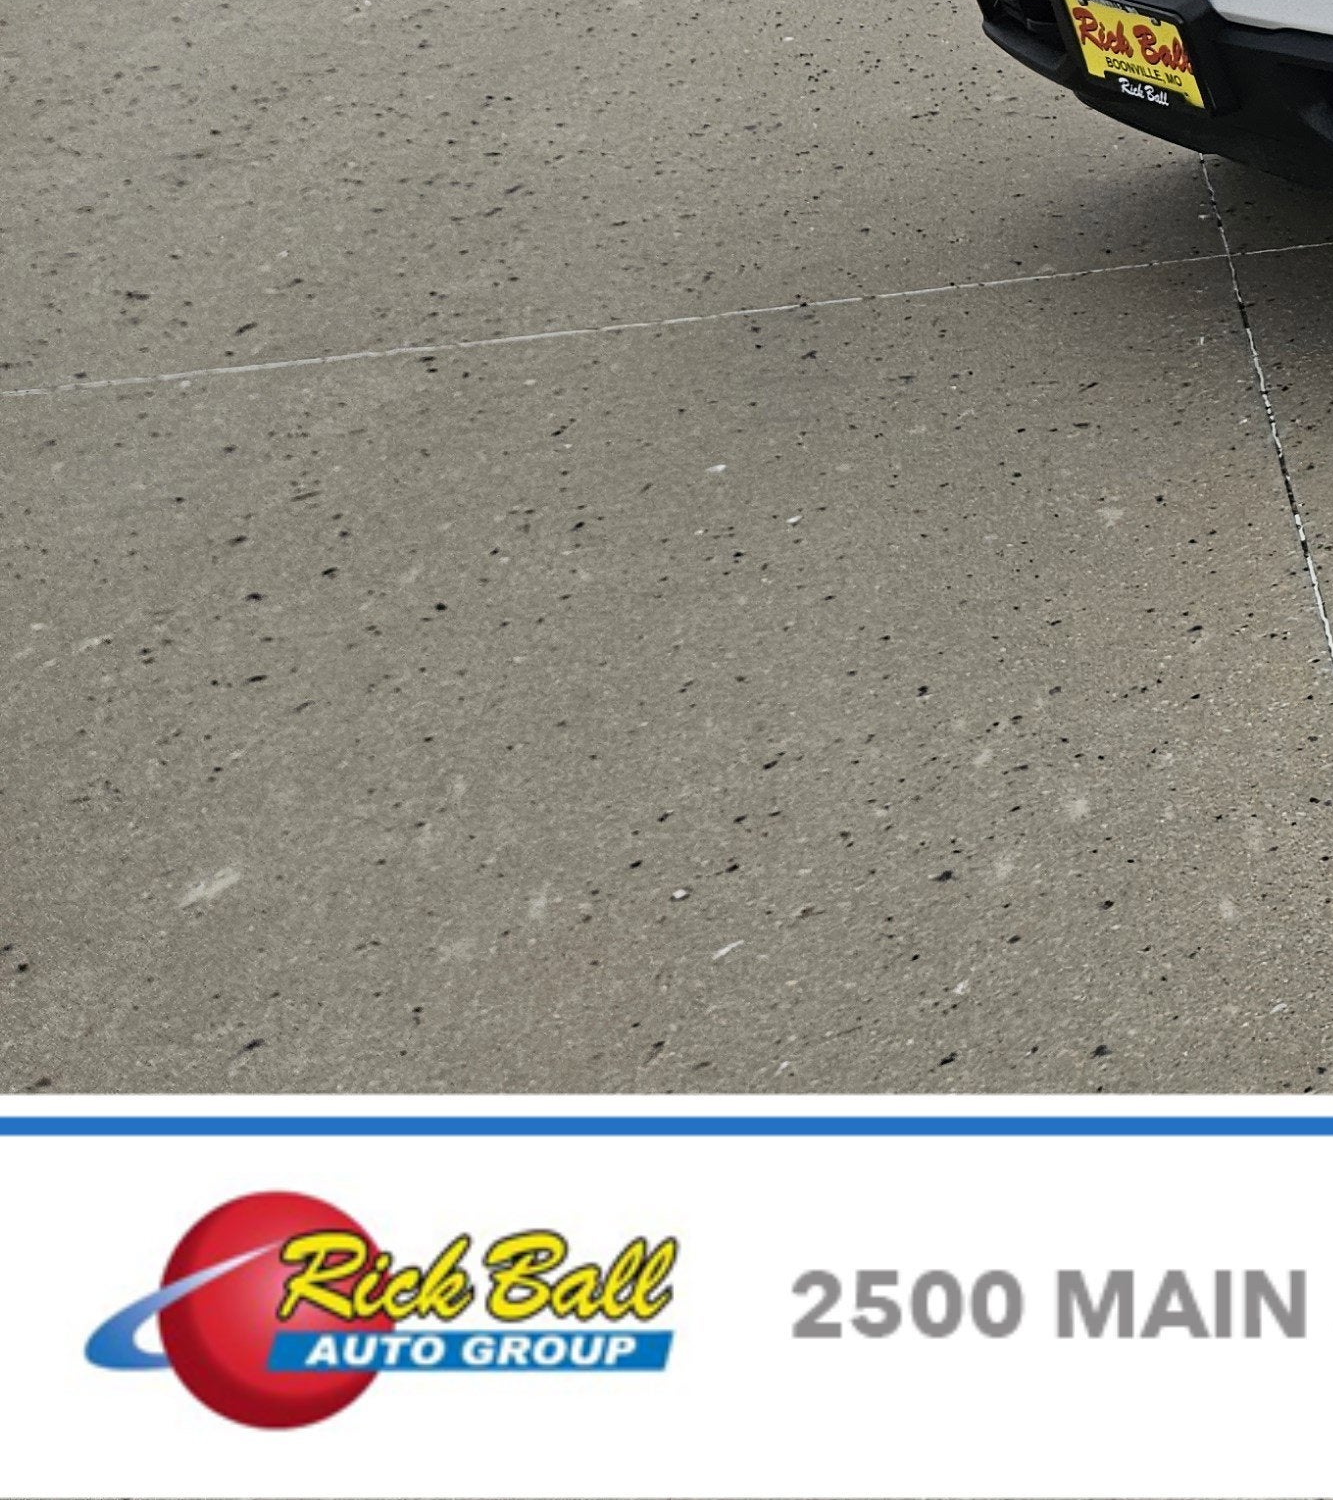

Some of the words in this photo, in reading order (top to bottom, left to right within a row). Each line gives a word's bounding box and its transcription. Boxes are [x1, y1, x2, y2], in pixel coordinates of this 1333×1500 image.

[1072, 7, 1134, 59] Rick
[1105, 56, 1167, 85] BOONVILLE,
[1165, 72, 1183, 87] MO
[1118, 77, 1145, 100] Rick
[1144, 85, 1170, 107] Ball
